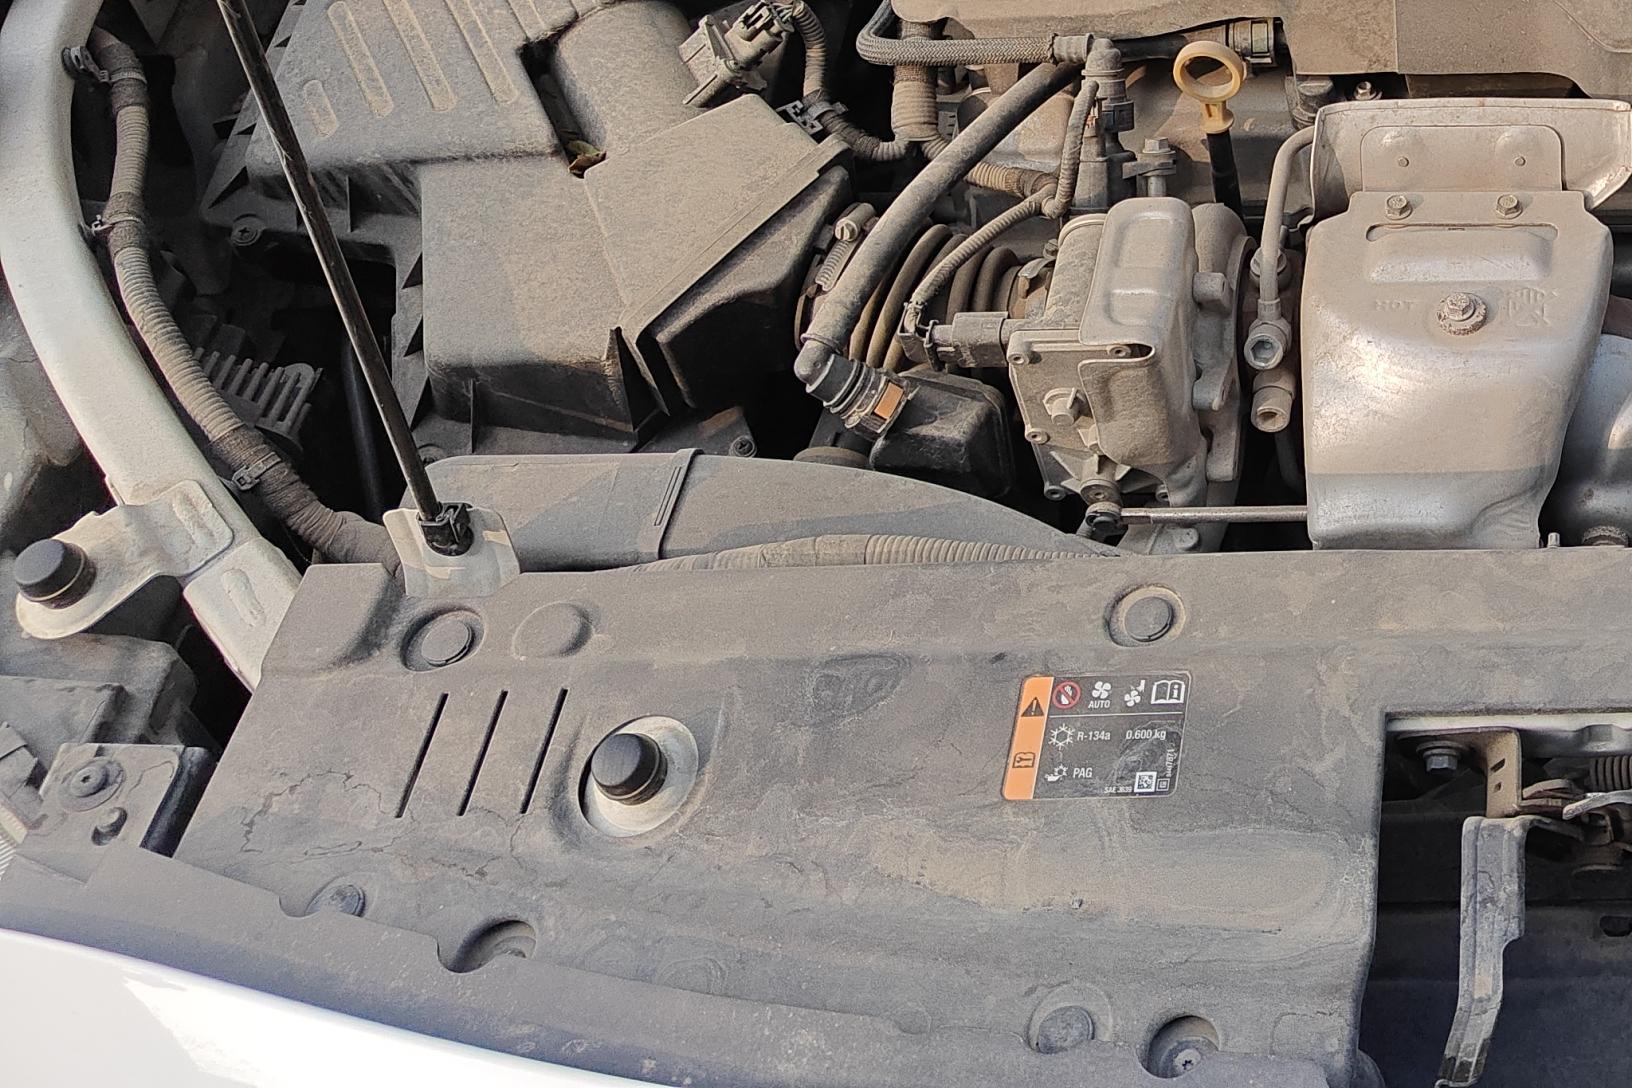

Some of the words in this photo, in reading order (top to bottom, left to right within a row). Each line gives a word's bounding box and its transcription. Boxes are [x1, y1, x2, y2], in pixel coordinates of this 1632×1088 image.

[1088, 700, 1110, 709] AUTO
[1076, 730, 1111, 741] R-134a
[1126, 730, 1152, 740] 0.600
[1152, 729, 1167, 741] kg
[1073, 767, 1093, 778] PAG
